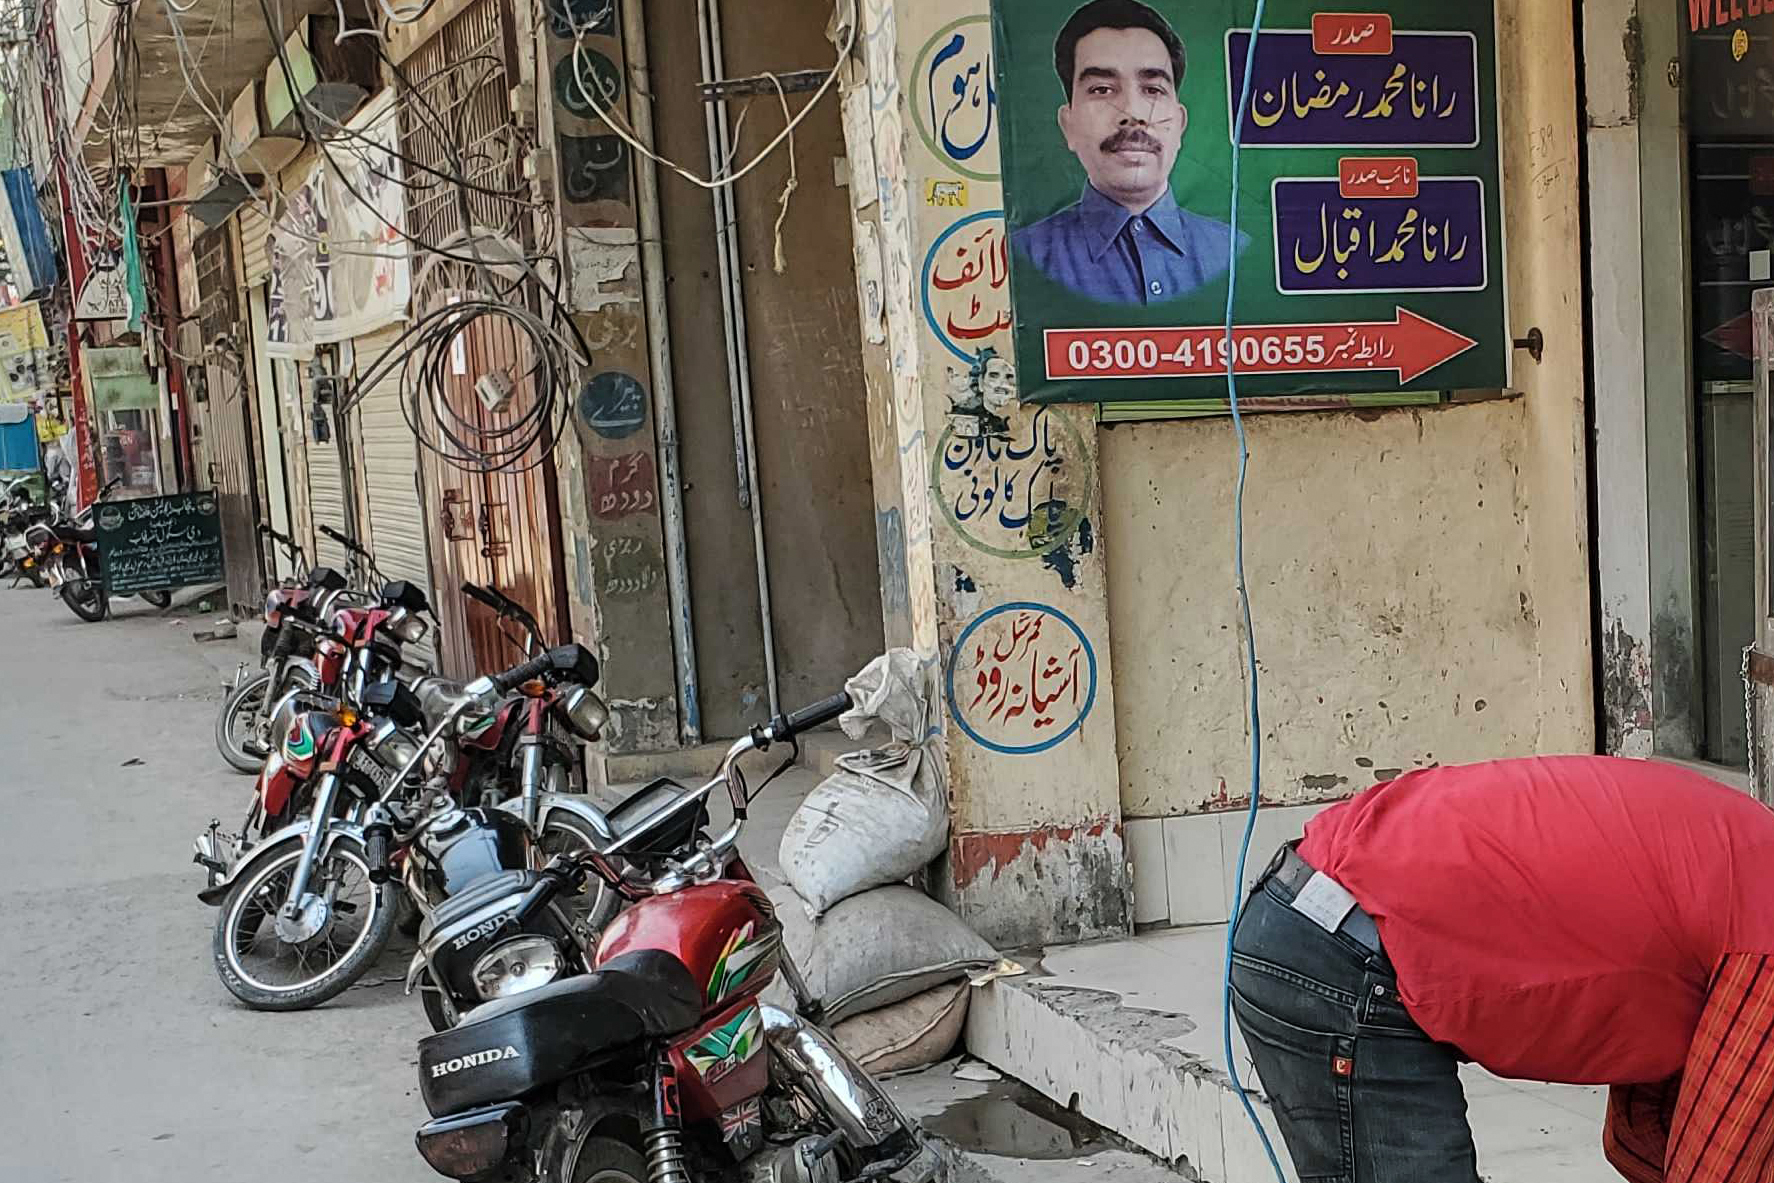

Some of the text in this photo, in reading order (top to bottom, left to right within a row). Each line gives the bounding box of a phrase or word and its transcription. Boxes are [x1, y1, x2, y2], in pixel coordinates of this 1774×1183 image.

[1332, 22, 1375, 46] صدر
[1250, 62, 1457, 127] رانا محمد رمضان
[568, 140, 622, 198] لسی
[1347, 165, 1412, 191] نائب صدر
[1294, 201, 1468, 280] رانا محمد اقبال
[1067, 328, 1396, 371] رابطہ نمبر 0300-4190655
[609, 453, 645, 488] گرم
[599, 489, 653, 514] دودھ
[968, 643, 1081, 728] آشیانہ روڈ
[431, 1045, 520, 1078] HONDA
